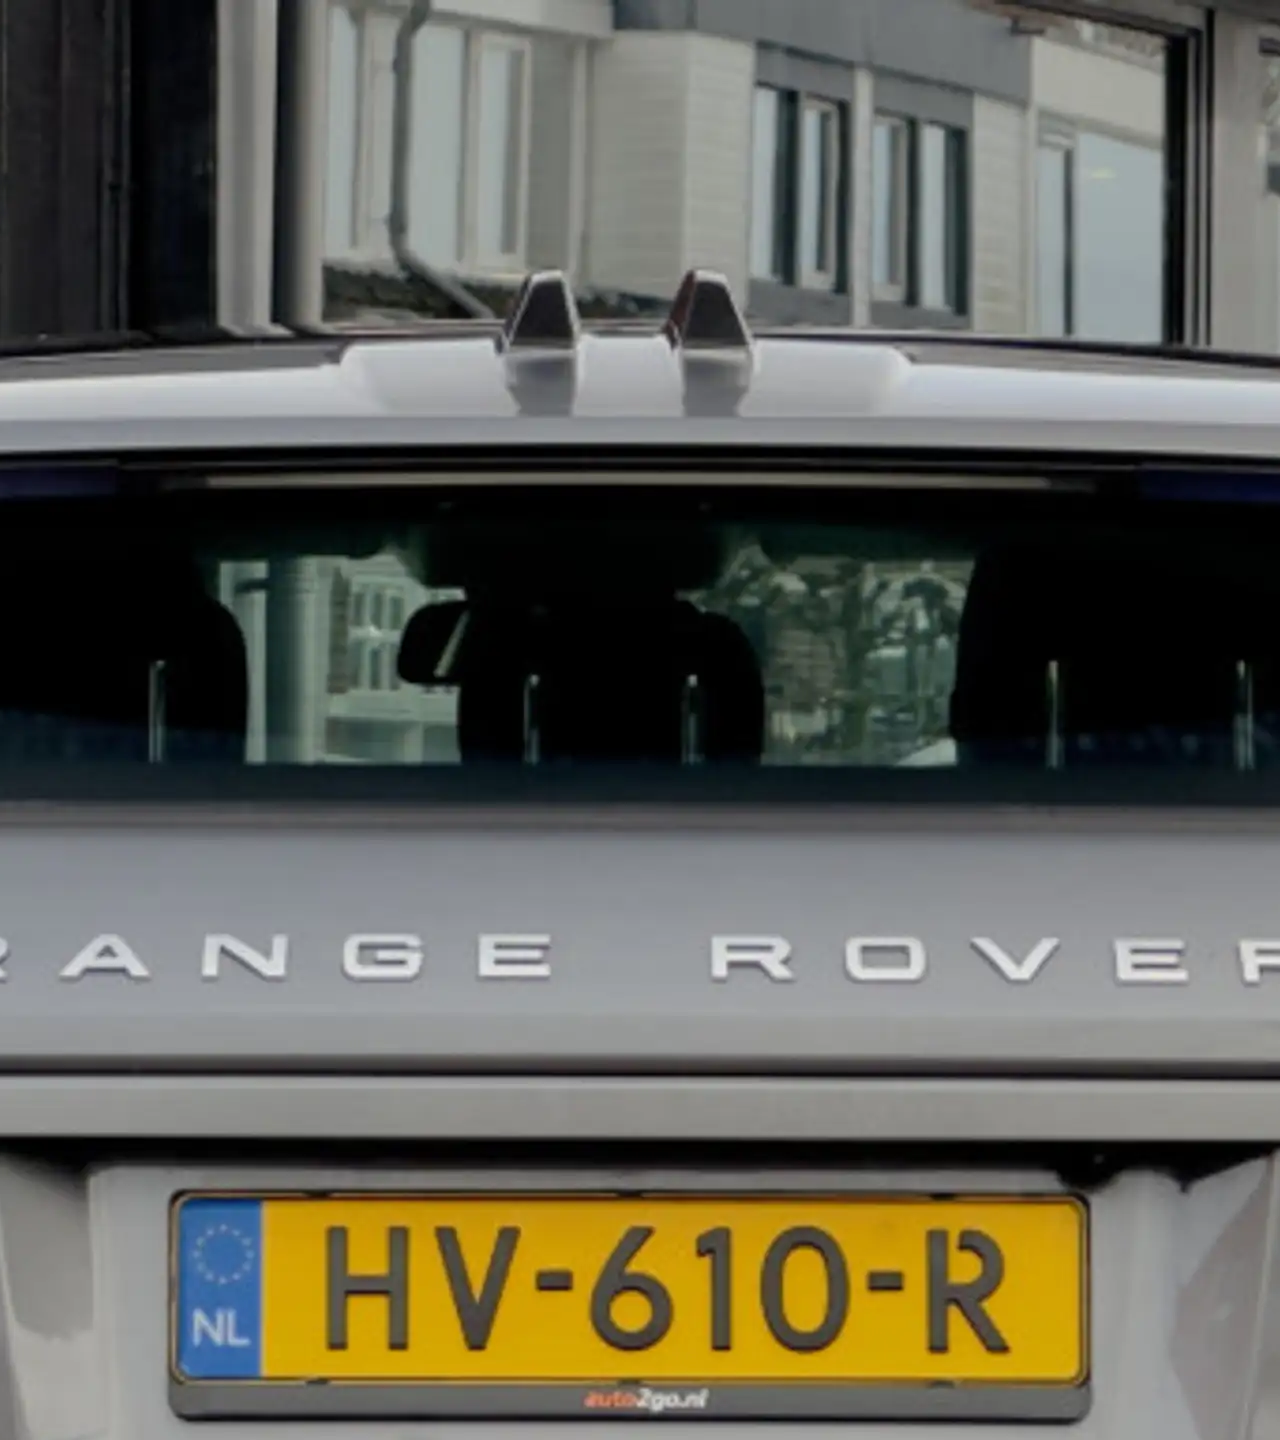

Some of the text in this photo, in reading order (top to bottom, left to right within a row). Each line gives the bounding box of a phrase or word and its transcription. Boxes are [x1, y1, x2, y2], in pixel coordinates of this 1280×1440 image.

[323, 1225, 1011, 1353] HV-610-R
[192, 1311, 250, 1347] NL
[584, 1388, 709, 1413] auto2go.nl
